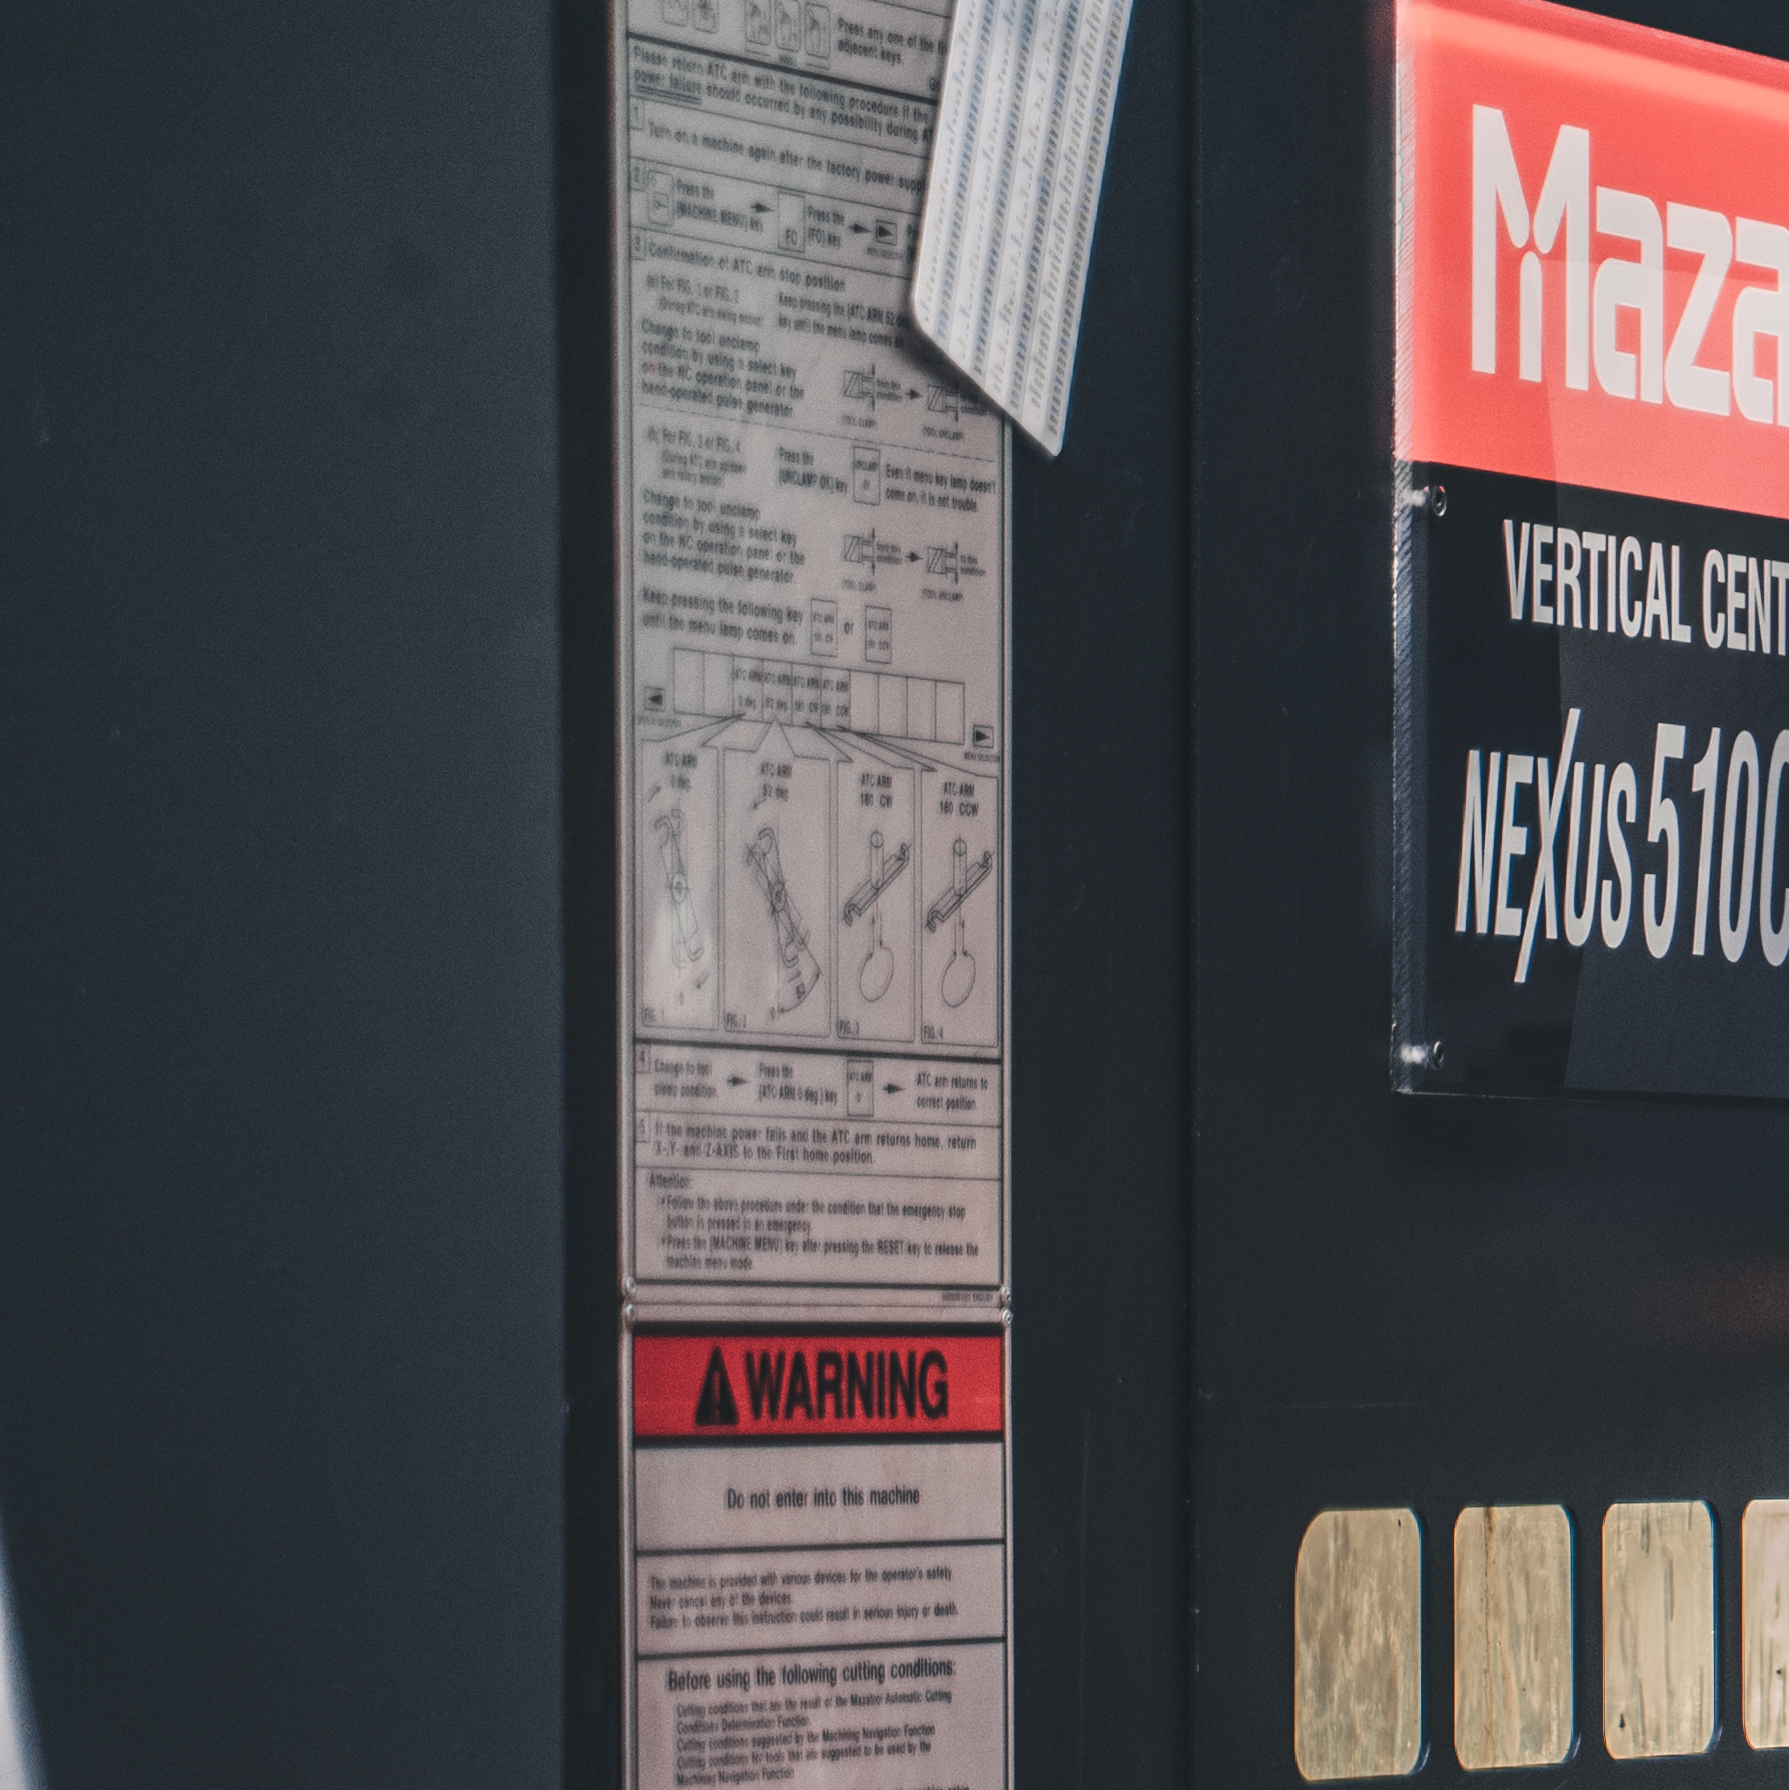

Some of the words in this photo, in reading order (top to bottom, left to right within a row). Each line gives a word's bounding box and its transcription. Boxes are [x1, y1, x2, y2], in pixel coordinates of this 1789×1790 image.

[1503, 519, 1692, 643] VERTICAL
[1455, 708, 1637, 983] NEXUS
[666, 1124, 682, 1137] the
[686, 1126, 726, 1138] machine
[731, 1128, 760, 1141] power
[766, 1127, 786, 1141] fails
[791, 1131, 808, 1142] and
[831, 1130, 848, 1143] ATC
[854, 1134, 871, 1145] arm
[877, 1134, 910, 1146] returns
[914, 1134, 941, 1148] home,
[948, 1136, 975, 1149] return
[744, 1350, 948, 1420] WARNING
[727, 1488, 744, 1509] Do
[750, 1491, 769, 1508] not
[775, 1490, 807, 1508] enter
[813, 1489, 836, 1506] into
[842, 1488, 863, 1505] this
[870, 1486, 920, 1505] machine
[668, 1671, 710, 1691] Before
[716, 1669, 750, 1691] using
[756, 1666, 775, 1686] the
[781, 1664, 837, 1687] following
[842, 1661, 885, 1684] cutting
[890, 1658, 955, 1679] conditions:
